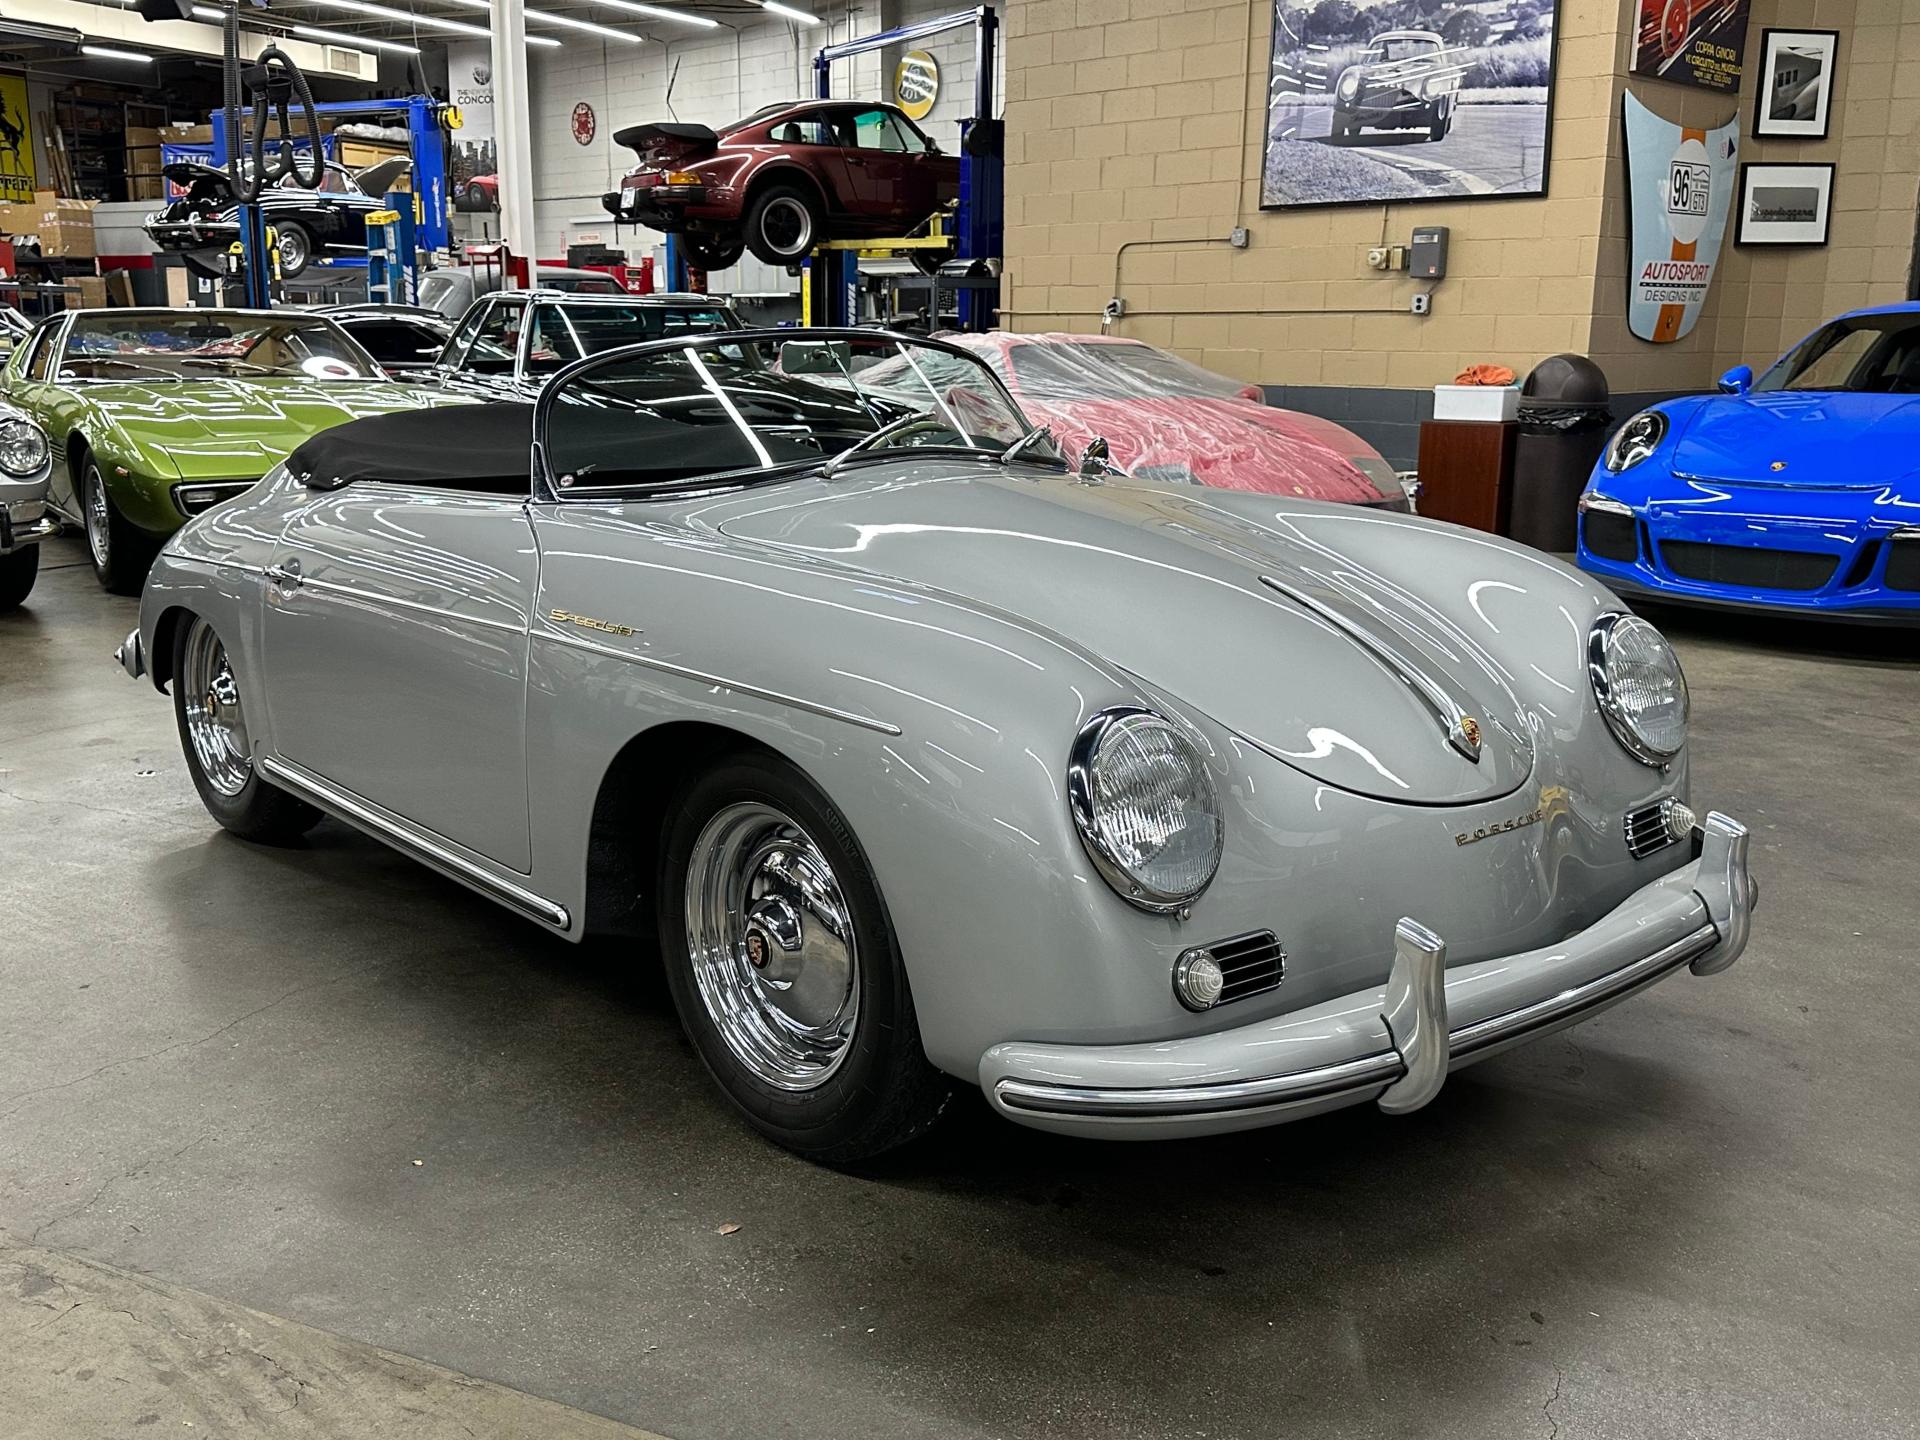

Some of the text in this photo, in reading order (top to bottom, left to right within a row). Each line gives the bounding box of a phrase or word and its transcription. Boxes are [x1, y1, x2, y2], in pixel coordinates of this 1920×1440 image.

[1695, 40, 1715, 57] COPPA
[1673, 168, 1690, 208] 96
[1693, 193, 1706, 211] GT3
[1641, 261, 1710, 281] AUTOSPORT
[1644, 289, 1688, 302] DESIGNS
[1454, 808, 1543, 848] PORSCHE
